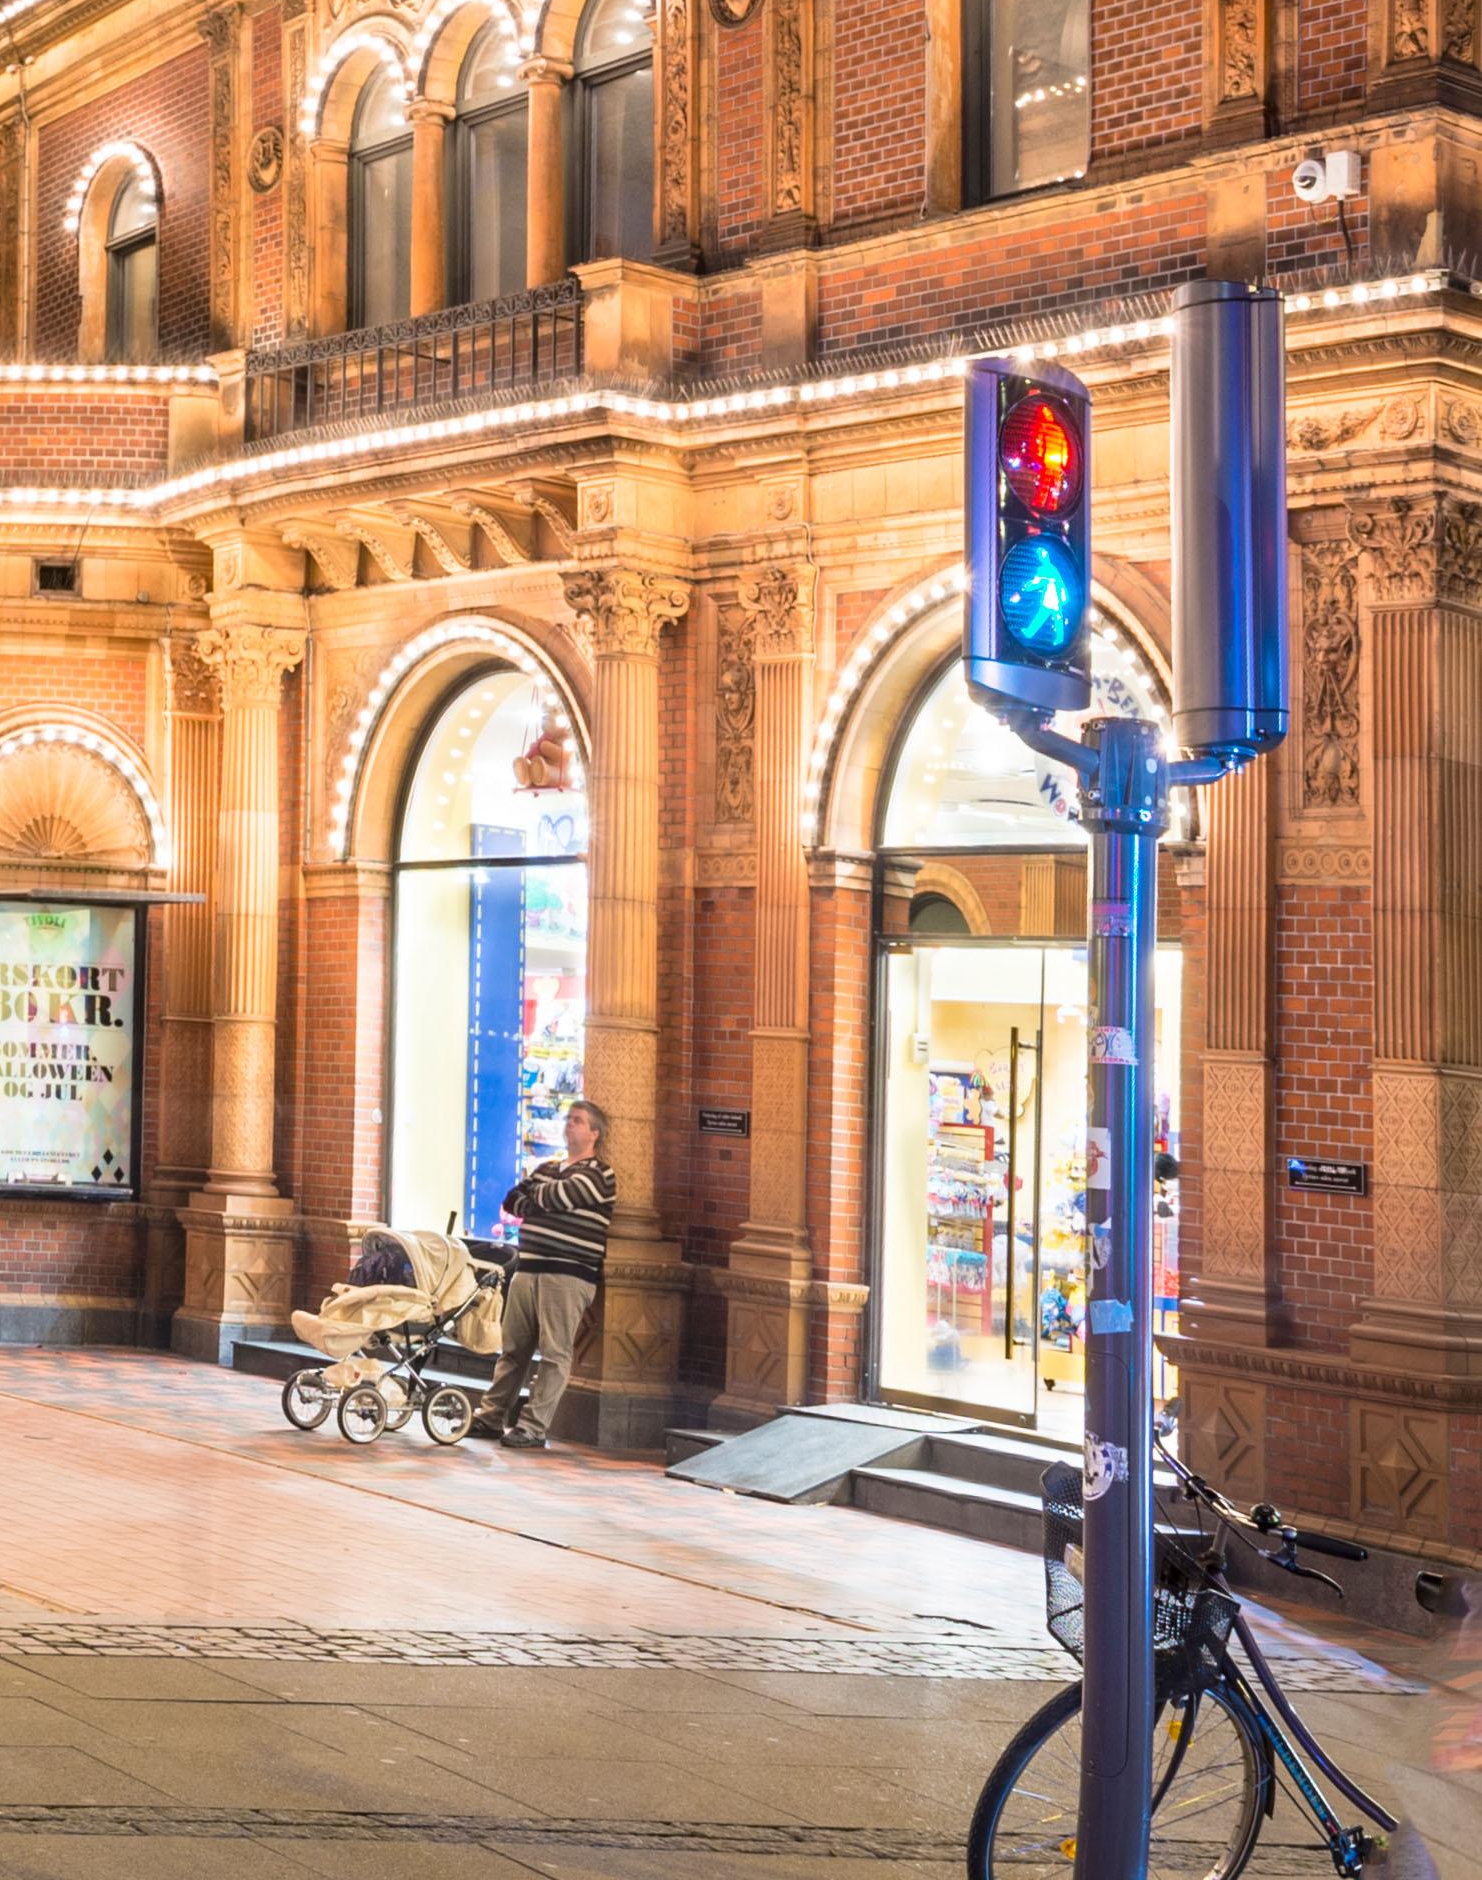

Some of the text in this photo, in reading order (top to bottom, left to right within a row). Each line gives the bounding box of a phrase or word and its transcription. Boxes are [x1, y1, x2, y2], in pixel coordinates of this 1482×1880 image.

[24, 914, 67, 929] TIVOLI
[47, 993, 124, 1028] KR.
[3, 1082, 83, 1102] OG JUL
